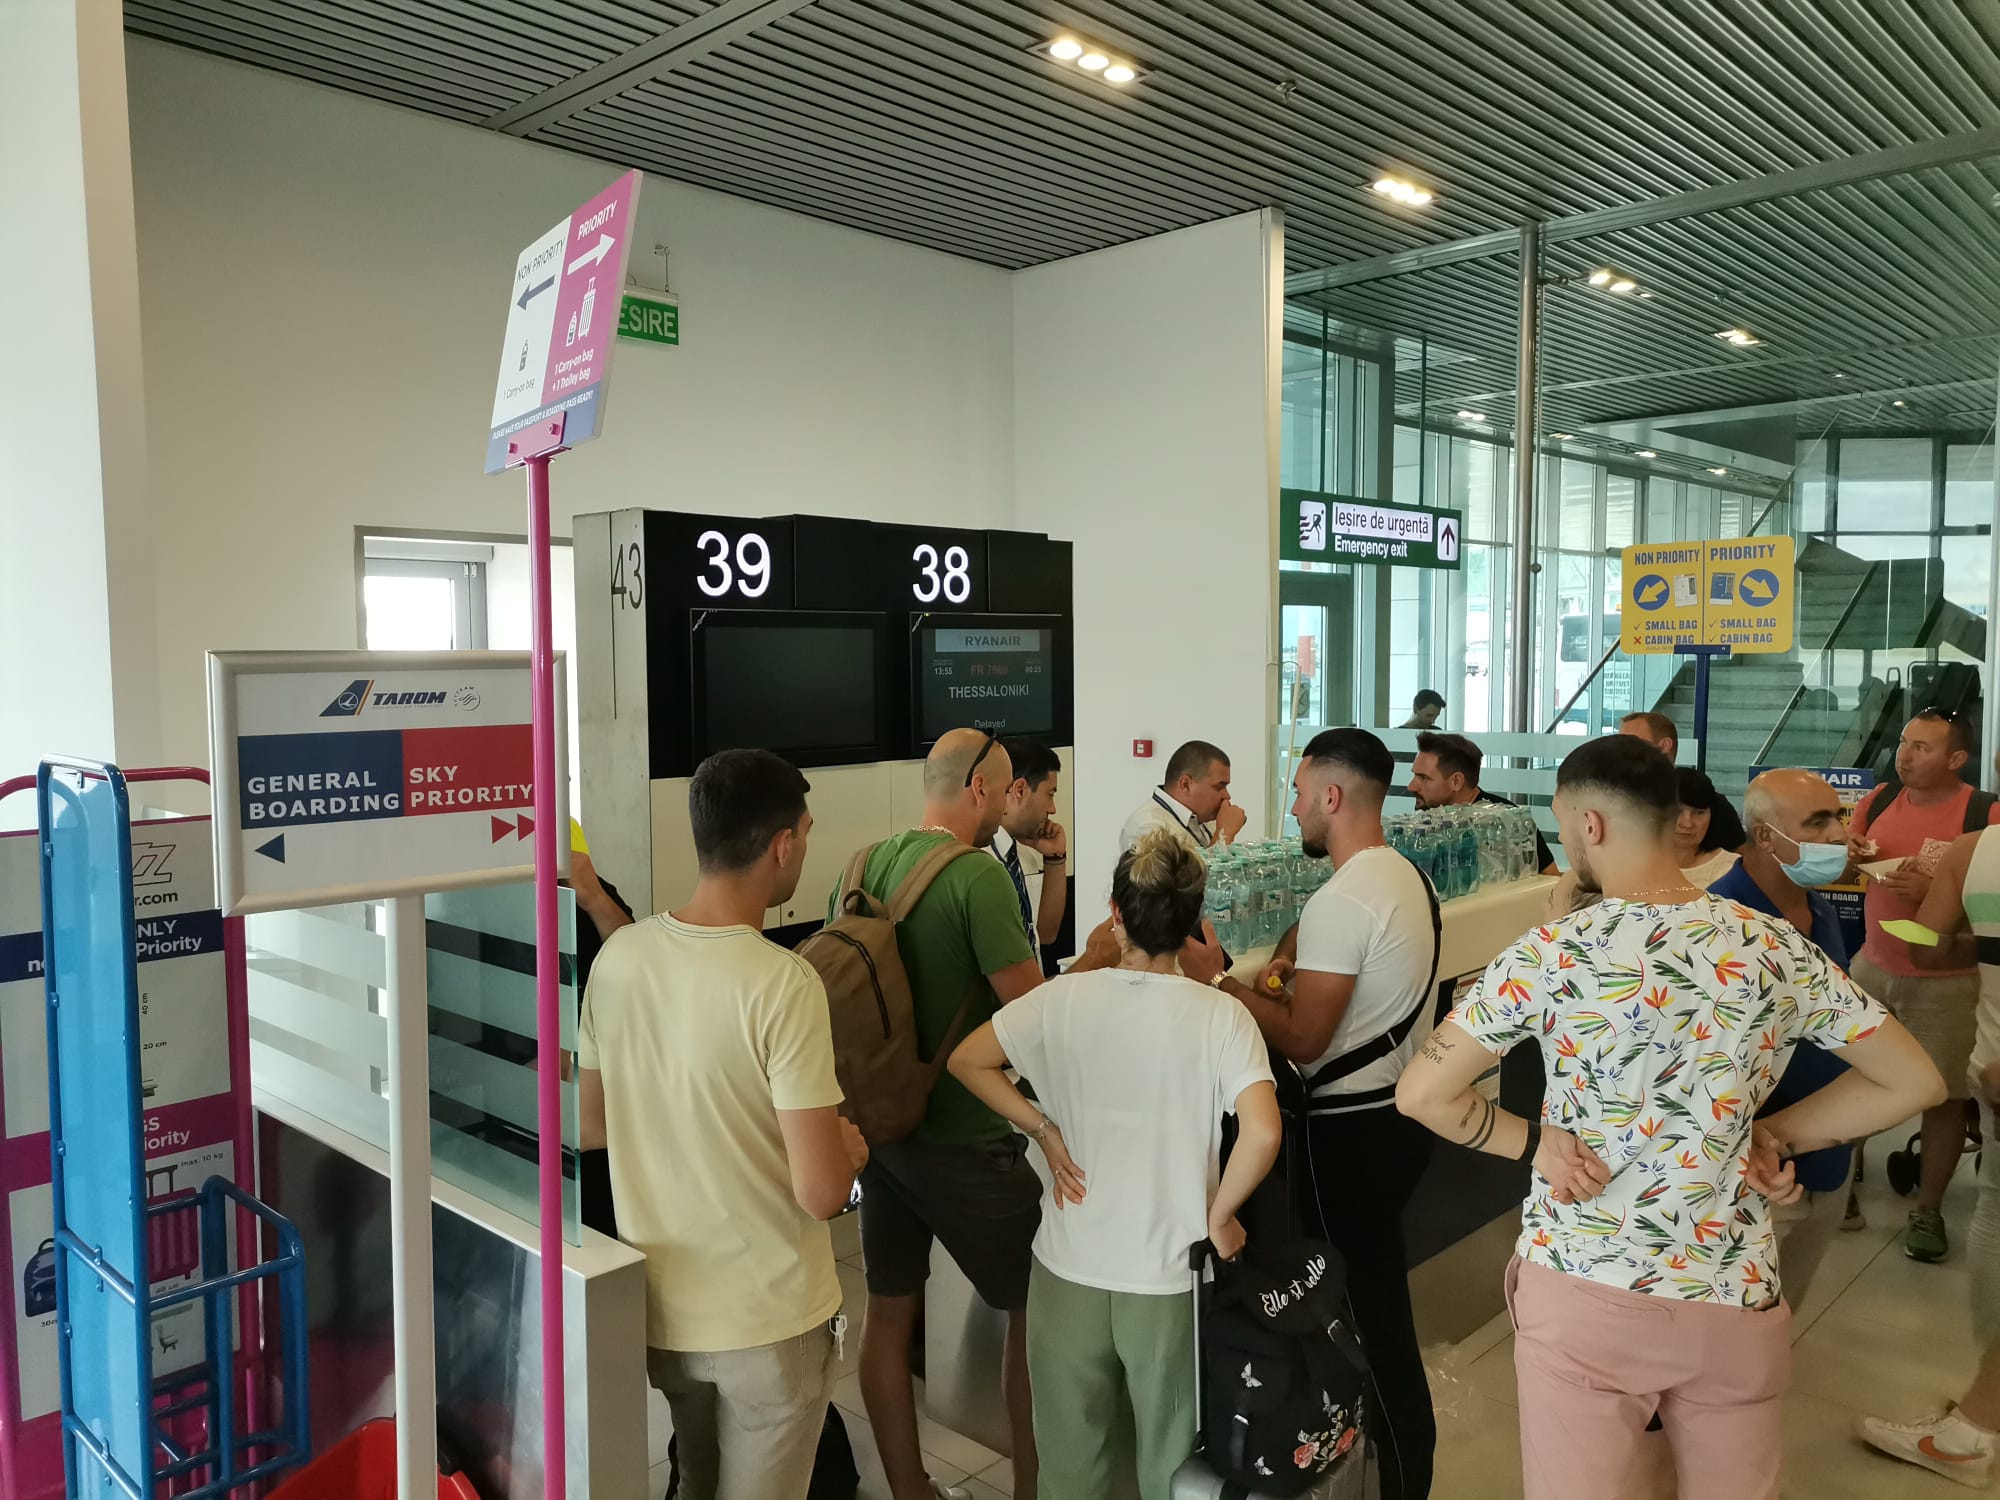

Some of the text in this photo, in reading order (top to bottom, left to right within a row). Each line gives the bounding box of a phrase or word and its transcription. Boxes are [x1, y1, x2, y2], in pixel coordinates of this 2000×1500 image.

[577, 199, 618, 241] PRIORITY
[517, 235, 566, 282] NON PRIORITY
[618, 303, 677, 338] ESIRE
[559, 354, 582, 374] Carry-on
[582, 348, 594, 363] bag
[560, 371, 579, 389] Trolley
[579, 367, 591, 381] bag
[1370, 511, 1385, 529] de
[1334, 535, 1408, 559] Emergency exit
[1710, 544, 1776, 561] PRIORITY
[697, 530, 771, 598] 39
[1634, 549, 1700, 566] NON PRIORITY
[611, 542, 643, 610] 43
[912, 544, 971, 603] 38
[1645, 619, 1698, 631] SMALL BAG
[1720, 617, 1777, 629] SMALL BAG
[965, 635, 1021, 647] RYANAIR
[1645, 634, 1695, 645] CABIN BAG
[1720, 632, 1773, 644] CABIN BAG
[934, 667, 953, 676] 13:55
[373, 691, 447, 706] TAROM
[948, 684, 1029, 699] THESSALONIKI
[974, 718, 1006, 728] Delayed
[248, 770, 376, 795] GENERAL
[409, 765, 458, 784] SKY
[410, 783, 533, 808] PRIORITY
[250, 793, 399, 820] BOARDING
[1832, 893, 1859, 902] BOARD
[137, 919, 177, 938] NLY
[135, 936, 202, 957] Priority
[144, 1130, 190, 1152] iority
[1258, 1289, 1289, 1318] Elle
[1288, 1279, 1305, 1301] st
